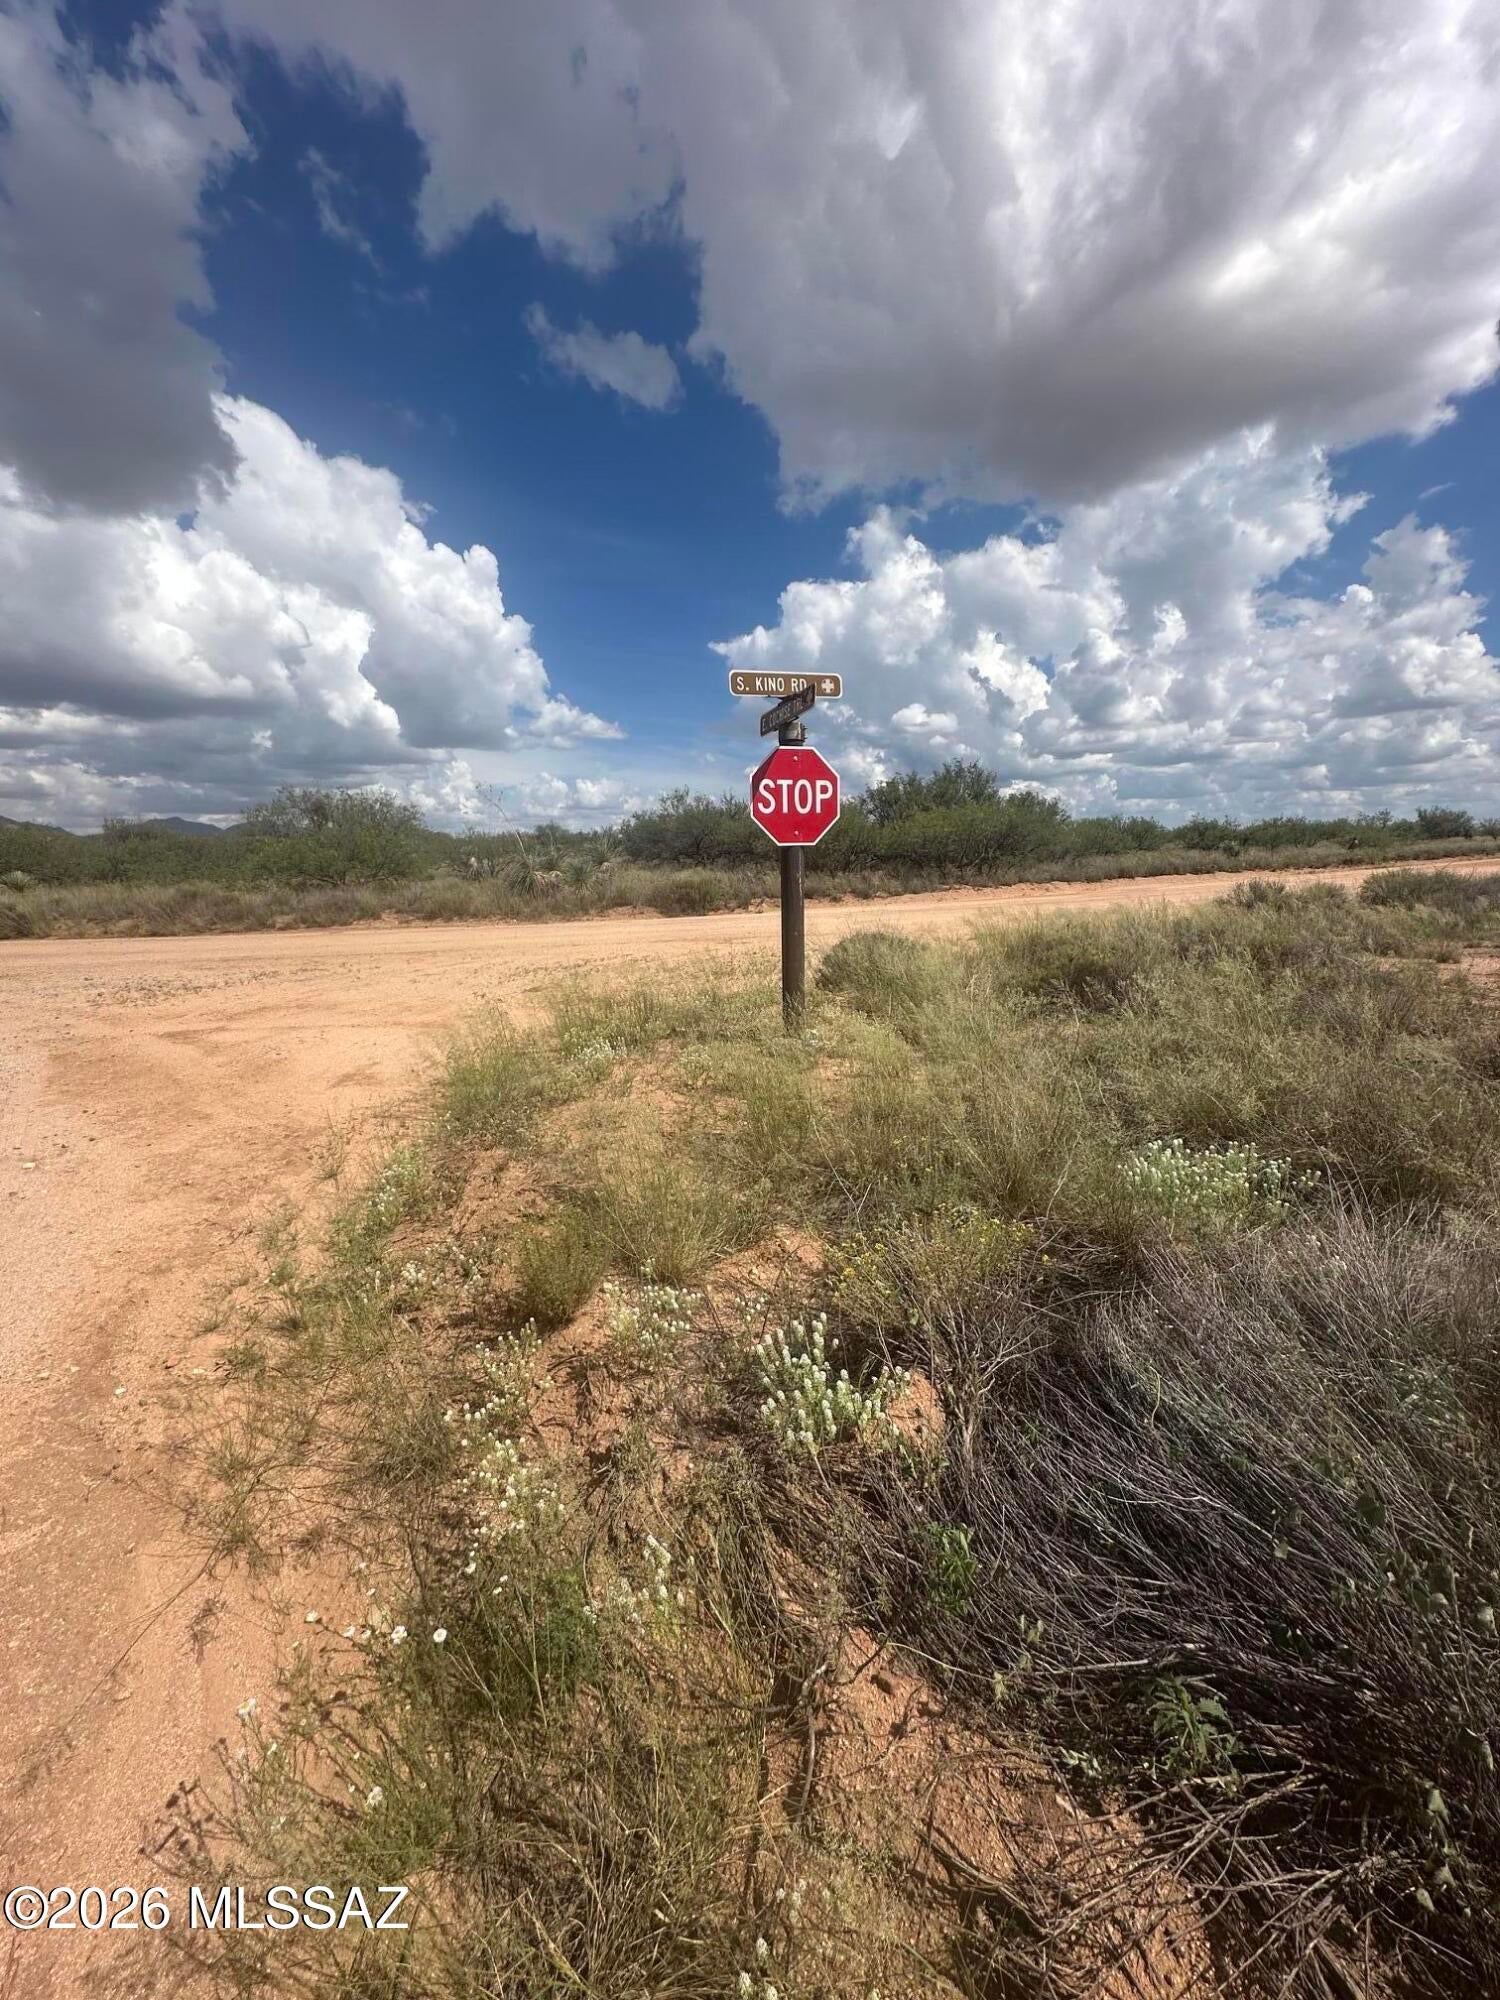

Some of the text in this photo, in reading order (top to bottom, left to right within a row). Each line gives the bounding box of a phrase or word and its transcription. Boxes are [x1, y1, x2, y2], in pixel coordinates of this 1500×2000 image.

[736, 676, 807, 692] S. KINO RD
[758, 778, 833, 814] STOP
